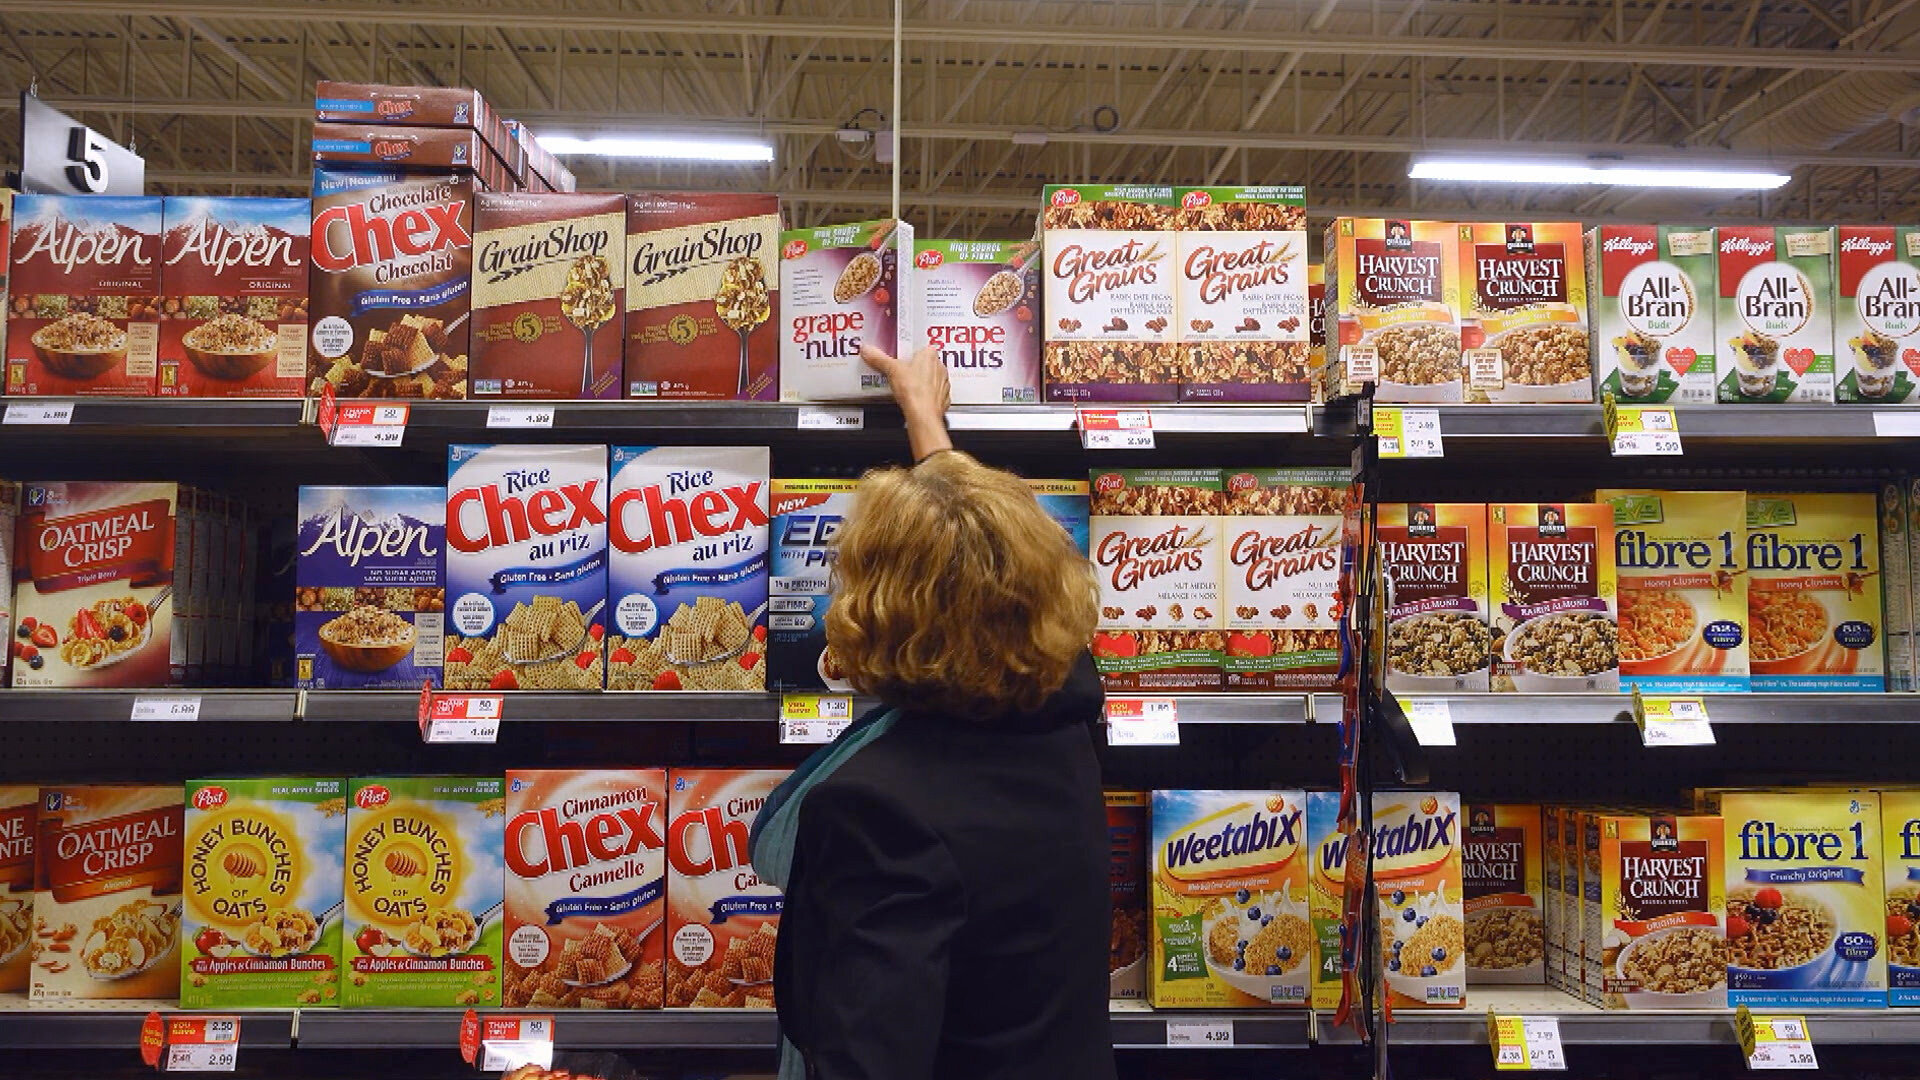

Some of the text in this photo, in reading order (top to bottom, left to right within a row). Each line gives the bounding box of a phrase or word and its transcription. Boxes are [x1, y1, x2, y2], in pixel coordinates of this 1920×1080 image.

[65, 126, 108, 193] 5
[370, 185, 452, 213] Chocolate
[15, 216, 151, 275] Alpen
[165, 217, 301, 276] Alpen
[311, 200, 473, 273] Chex
[950, 243, 1001, 252] HIGH SOURCE
[1603, 237, 1656, 255] Kellogg's
[1720, 237, 1773, 255] Kellogg's
[1841, 237, 1894, 255] Kellogg's
[479, 225, 608, 272] GrainShop
[633, 227, 762, 275] GrainShop
[1053, 239, 1143, 278] Great
[375, 253, 453, 284] Chocolat
[1185, 240, 1274, 280] Great
[1359, 255, 1439, 277] HARVEST
[1479, 259, 1562, 280] HARVEST
[1068, 262, 1157, 304] Grains
[1199, 263, 1288, 305] Grains
[1365, 276, 1433, 295] CRUNCH
[1486, 279, 1558, 297] CRUNCH
[1641, 277, 1680, 298] All-
[1758, 277, 1798, 299] All-
[1877, 277, 1918, 299] All-
[392, 296, 411, 305] Free
[1628, 296, 1685, 317] Bran
[1746, 296, 1803, 317] Bran
[521, 318, 535, 338] 5
[677, 320, 691, 339] 5
[793, 312, 864, 343] grape
[927, 325, 1005, 351] grape
[503, 469, 550, 493] Rice
[667, 471, 713, 495] Rice
[777, 497, 807, 512] NEW
[447, 479, 607, 553] Chex
[609, 481, 769, 553] Chex
[39, 512, 155, 550] OATMEAL
[301, 506, 437, 567] Alpen
[64, 537, 132, 567] CRISP
[530, 532, 590, 561] au riz
[693, 534, 754, 561] au riz
[1096, 524, 1188, 566] Great
[1230, 524, 1322, 566] Great
[1381, 542, 1465, 563] HARVEST
[1510, 542, 1594, 563] HARVEST
[1615, 529, 1737, 568] fibre 1
[1747, 533, 1868, 570] fibre 1
[501, 573, 526, 583] Gluten
[529, 573, 546, 581] Free
[1111, 549, 1203, 591] Grains
[1245, 549, 1337, 591] Grains
[1389, 565, 1458, 583] CRUNCH
[1518, 565, 1588, 583] CRUNCH
[1644, 576, 1709, 589] Honey Clusters
[1804, 578, 1840, 588] Clusters
[198, 791, 223, 806] Post
[361, 789, 386, 804] Post
[563, 787, 647, 818] Cinnamon
[727, 798, 764, 817] Cinn
[58, 817, 176, 859] OATMEAL
[505, 802, 664, 878] Chex
[668, 807, 750, 877] Ch
[1167, 810, 1302, 868] Weetabix
[1738, 820, 1868, 861] fibre 1
[83, 843, 154, 875] CRISP
[191, 819, 291, 895] HONEY BUNCHES
[353, 818, 452, 895] HONEY BUNCHES
[1462, 843, 1521, 862] ARVEST
[570, 859, 645, 892] Cannelle
[1463, 863, 1517, 880] RUNCH
[1623, 857, 1704, 880] HARVEST
[1770, 869, 1843, 882] Crunchy Original
[1630, 879, 1700, 898] CRUNCH
[213, 898, 267, 918] OATS
[374, 898, 427, 917] OATS
[721, 902, 767, 912] Gluten Free
[1646, 916, 1686, 930] ORIGINAL
[210, 958, 326, 974] Apples Cinnamon Bunches
[370, 959, 397, 973] Apples
[405, 959, 447, 970] Cinnamon
[450, 959, 484, 970] Bunches
[1167, 957, 1177, 972] 4
[212, 1022, 233, 1030] 2.50
[1206, 1031, 1229, 1041] 4.99
[209, 1055, 233, 1065] 2.99
